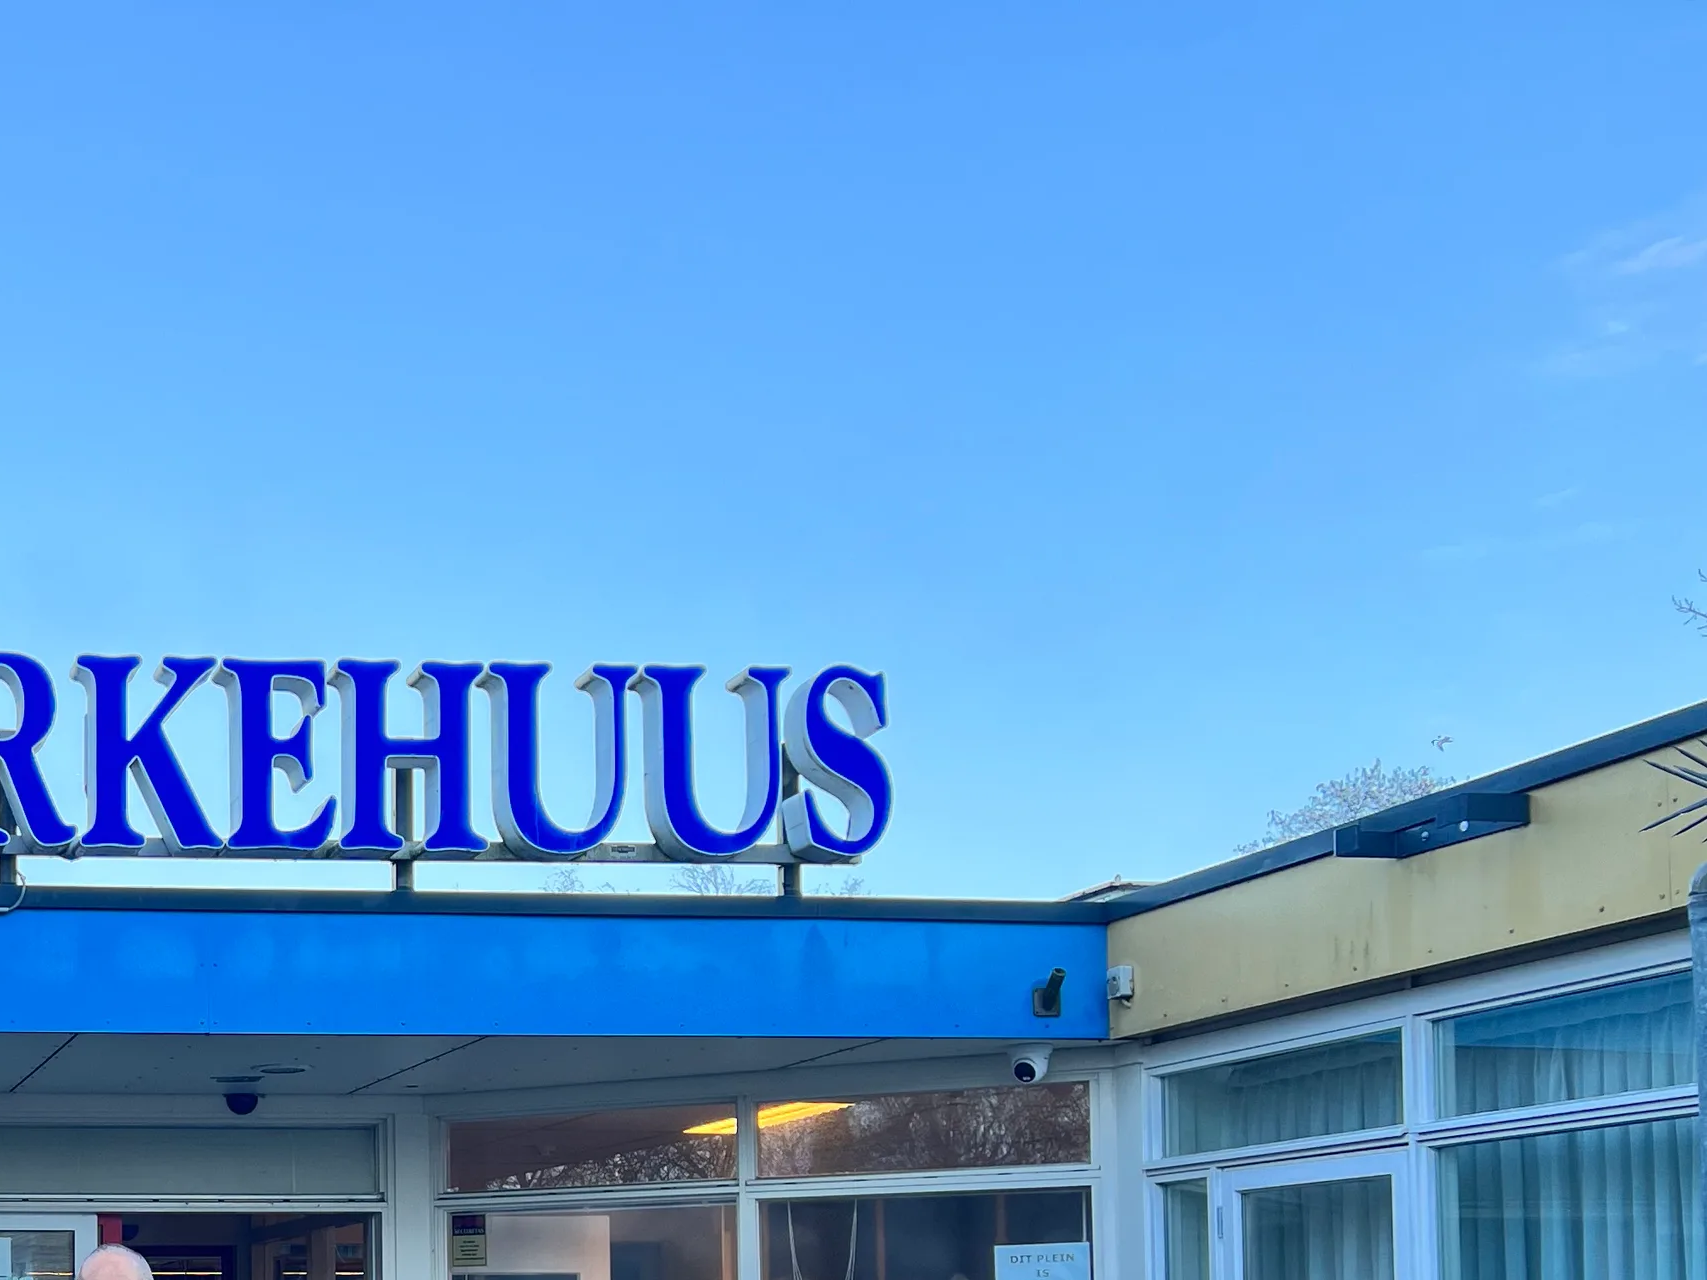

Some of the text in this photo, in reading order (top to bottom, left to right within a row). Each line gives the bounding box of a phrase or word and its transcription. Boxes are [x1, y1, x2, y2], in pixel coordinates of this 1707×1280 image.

[1010, 1253, 1075, 1264] DIT PLEIN
[1036, 1268, 1050, 1278] IS
